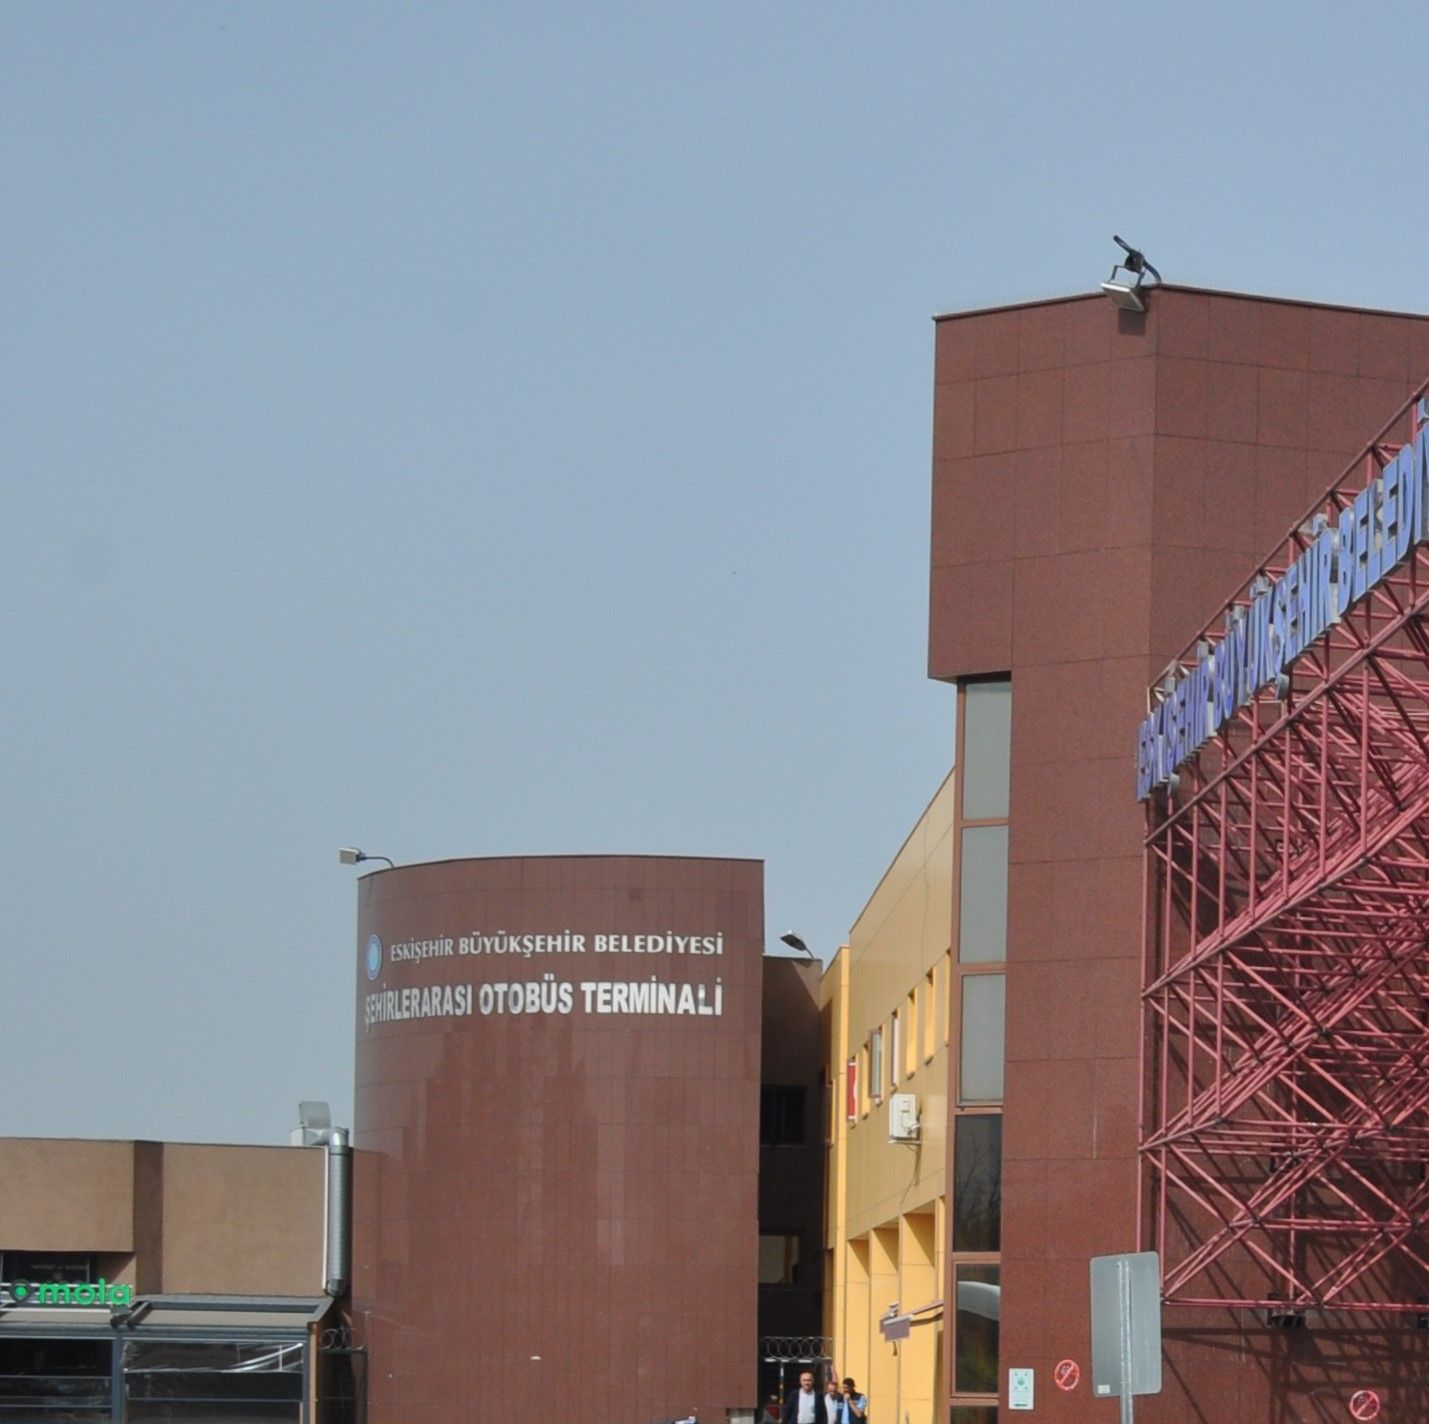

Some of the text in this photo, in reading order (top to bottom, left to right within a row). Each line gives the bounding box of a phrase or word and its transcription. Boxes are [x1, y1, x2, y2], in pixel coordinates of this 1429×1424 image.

[390, 935, 454, 963] ESKİŞEHİR
[458, 929, 586, 958] BÜYÜKŞEHİR
[595, 930, 724, 956] BELEDİYESİ
[365, 973, 722, 1032] ŞEHİRLERARASI OTOBÜS TERMİNALİ
[39, 1278, 130, 1305] mola
